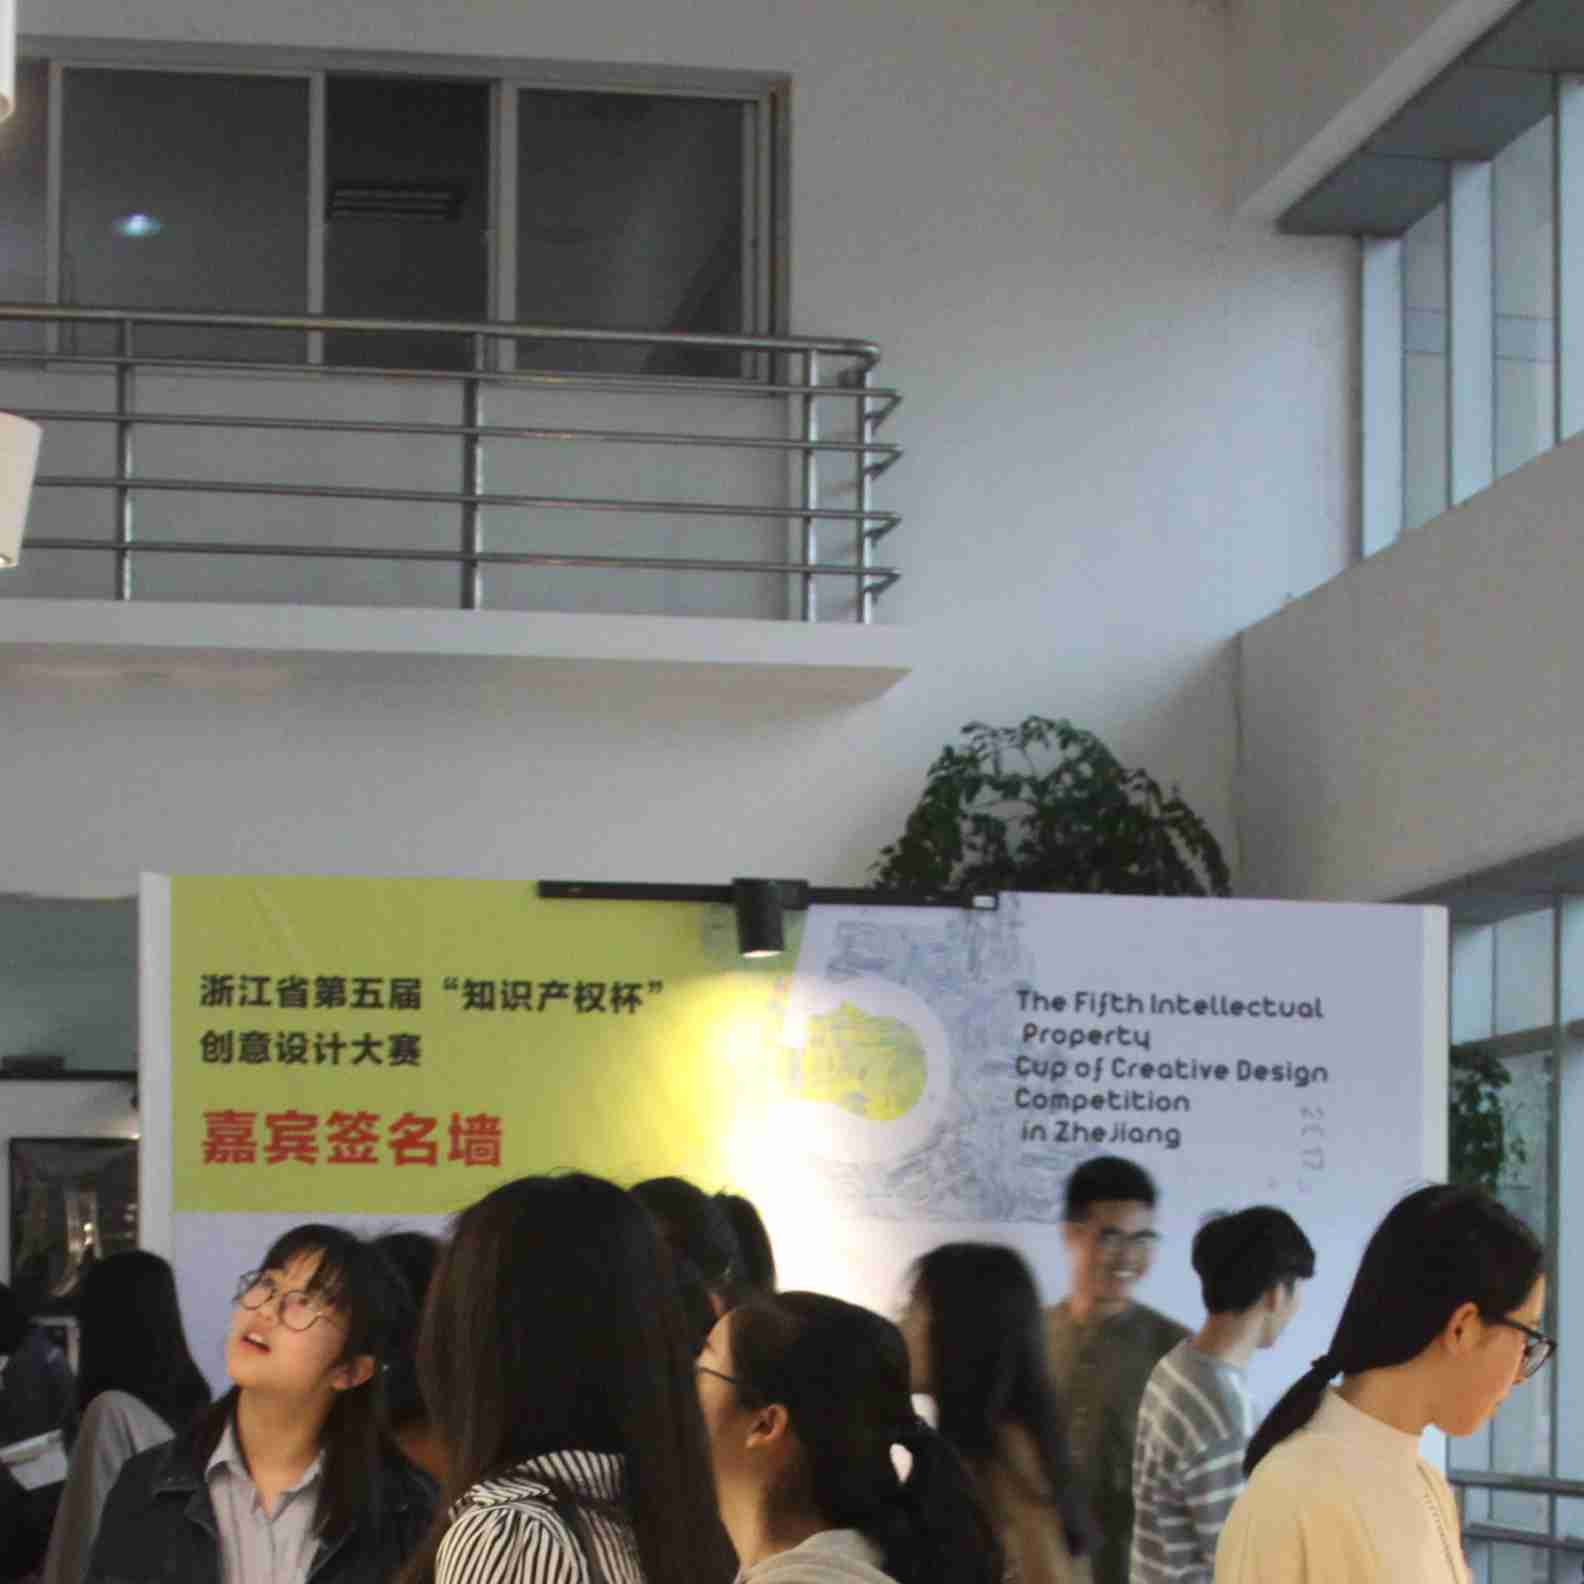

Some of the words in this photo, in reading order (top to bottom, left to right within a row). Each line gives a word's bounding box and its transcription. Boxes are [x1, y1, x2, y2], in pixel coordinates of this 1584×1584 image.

[1016, 988, 1067, 1012] The
[1074, 990, 1145, 1018] Fifth
[1150, 993, 1324, 1019] Intellectual
[200, 1029, 422, 1067] 创意设计大赛
[1022, 1022, 1151, 1051] Property
[1015, 1055, 1067, 1082] Cup
[1074, 1057, 1104, 1083] of
[1111, 1056, 1230, 1081] Creative
[1236, 1058, 1329, 1088] Design
[1015, 1087, 1191, 1114] Competition
[202, 1110, 503, 1168] 嘉宾签名墙
[1021, 1121, 1047, 1142] in
